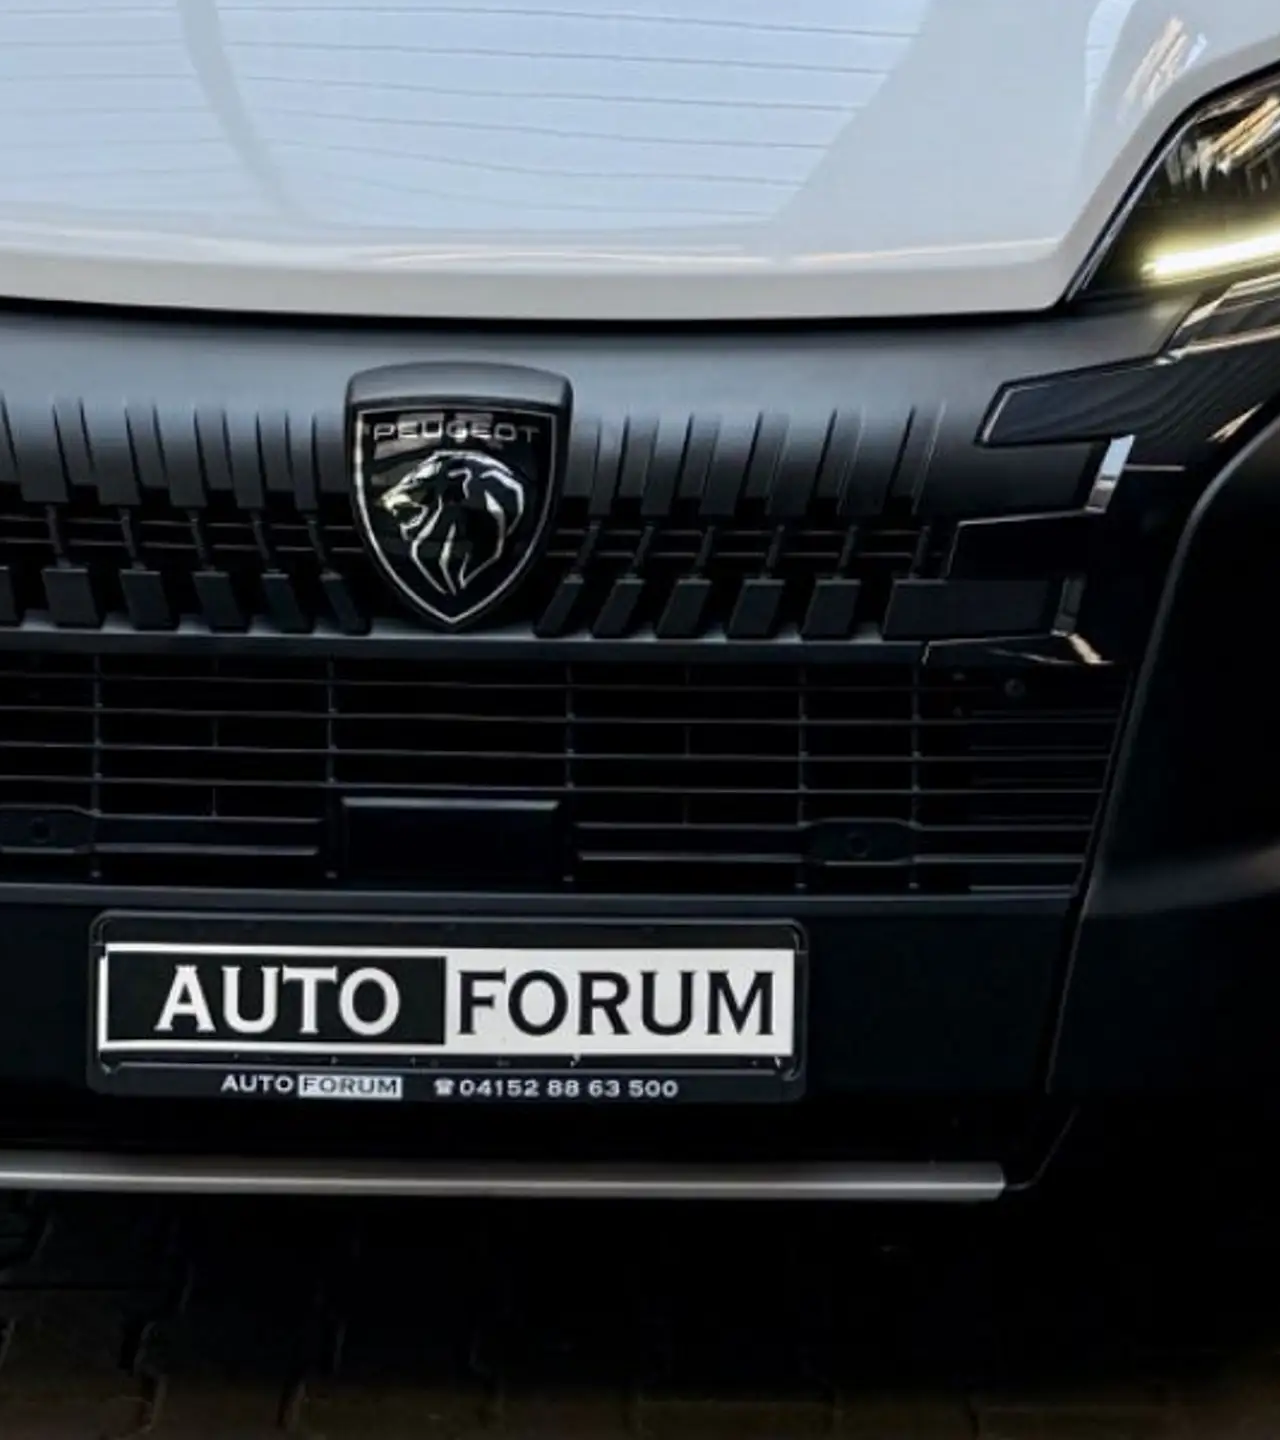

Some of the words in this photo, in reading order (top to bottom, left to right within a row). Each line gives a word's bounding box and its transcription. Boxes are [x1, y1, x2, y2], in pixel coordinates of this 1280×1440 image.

[373, 420, 541, 443] PEUGEOT
[153, 964, 401, 1036] AUTO
[457, 968, 774, 1037] FORUM
[220, 1074, 295, 1094] AUTO
[302, 1076, 399, 1096] FORUM
[459, 1078, 540, 1098] 04152
[546, 1079, 580, 1098] 88
[587, 1079, 621, 1098] 63
[628, 1079, 680, 1099] 500
